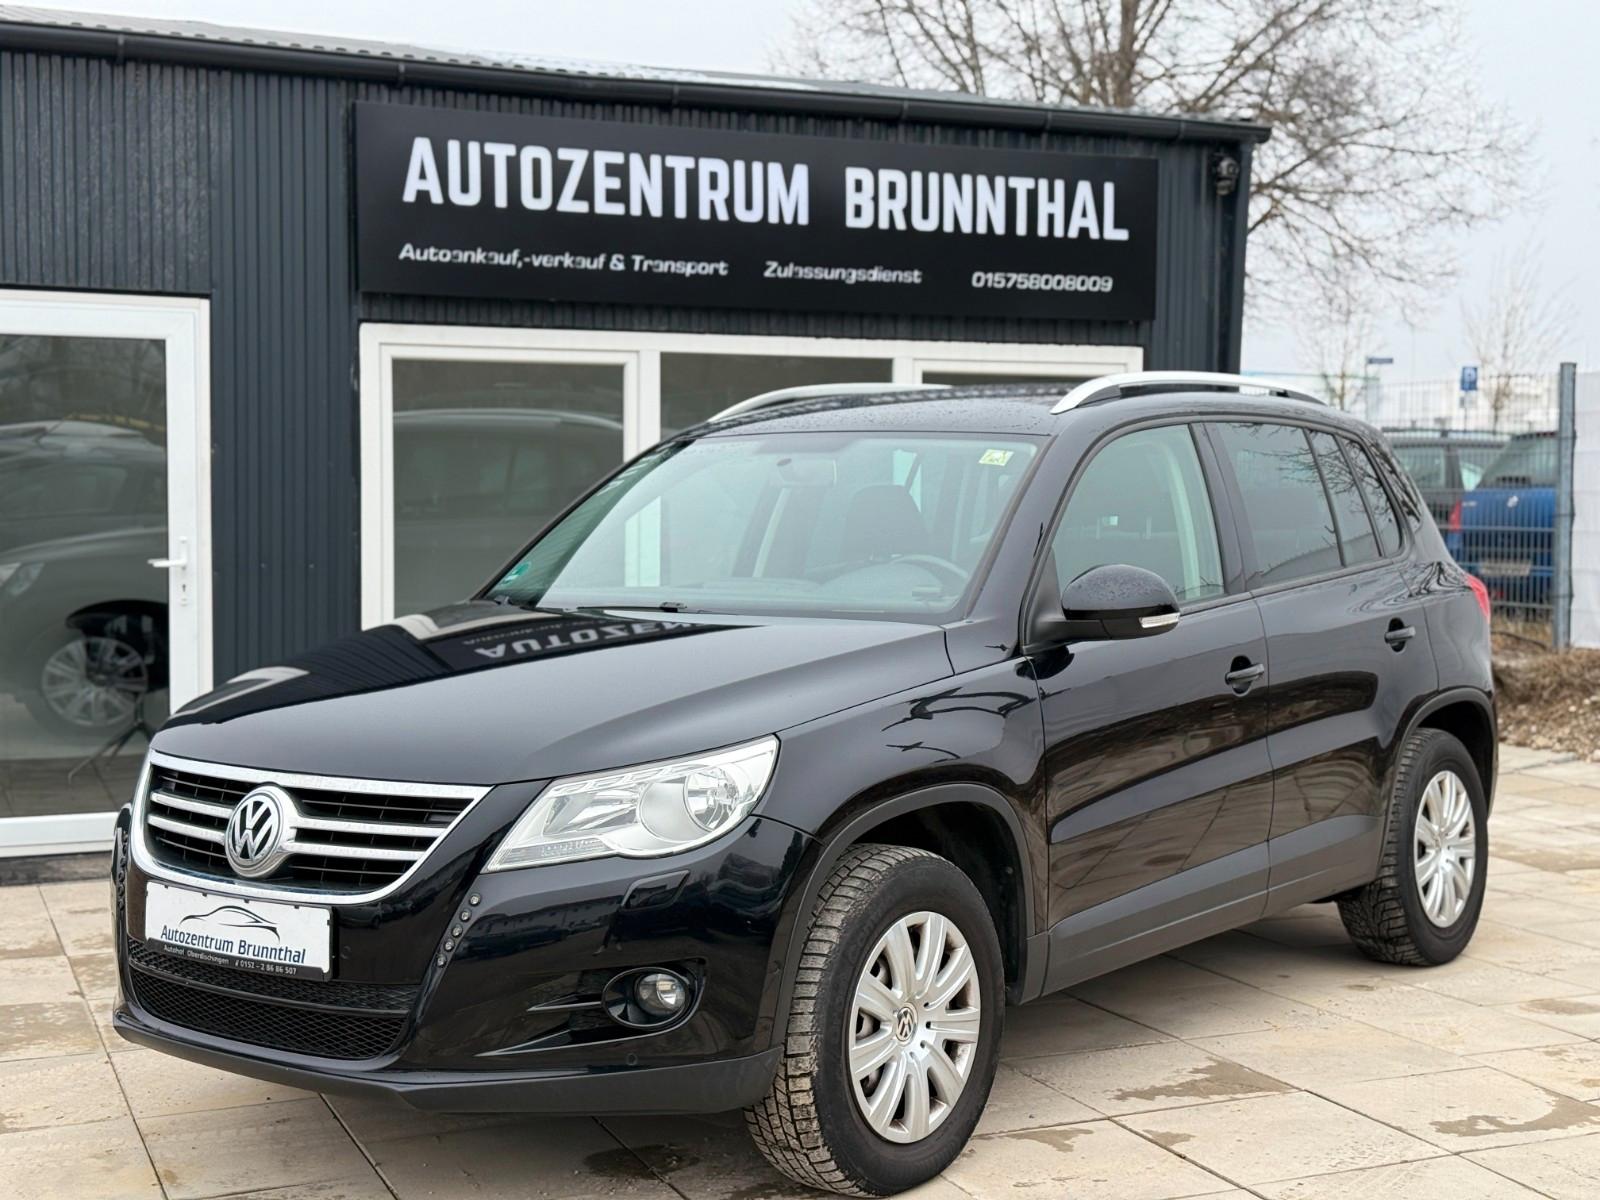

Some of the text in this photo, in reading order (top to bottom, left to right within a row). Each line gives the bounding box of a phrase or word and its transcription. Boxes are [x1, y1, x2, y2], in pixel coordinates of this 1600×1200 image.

[402, 136, 1129, 241] AUTOZENTRUM BRUNNTHAL
[609, 253, 626, 271] &
[631, 254, 728, 277] Transport
[763, 260, 922, 284] Zulassungsdienst
[971, 271, 1113, 292] 015758008009
[160, 925, 306, 964] Autozentrum Brunnthal
